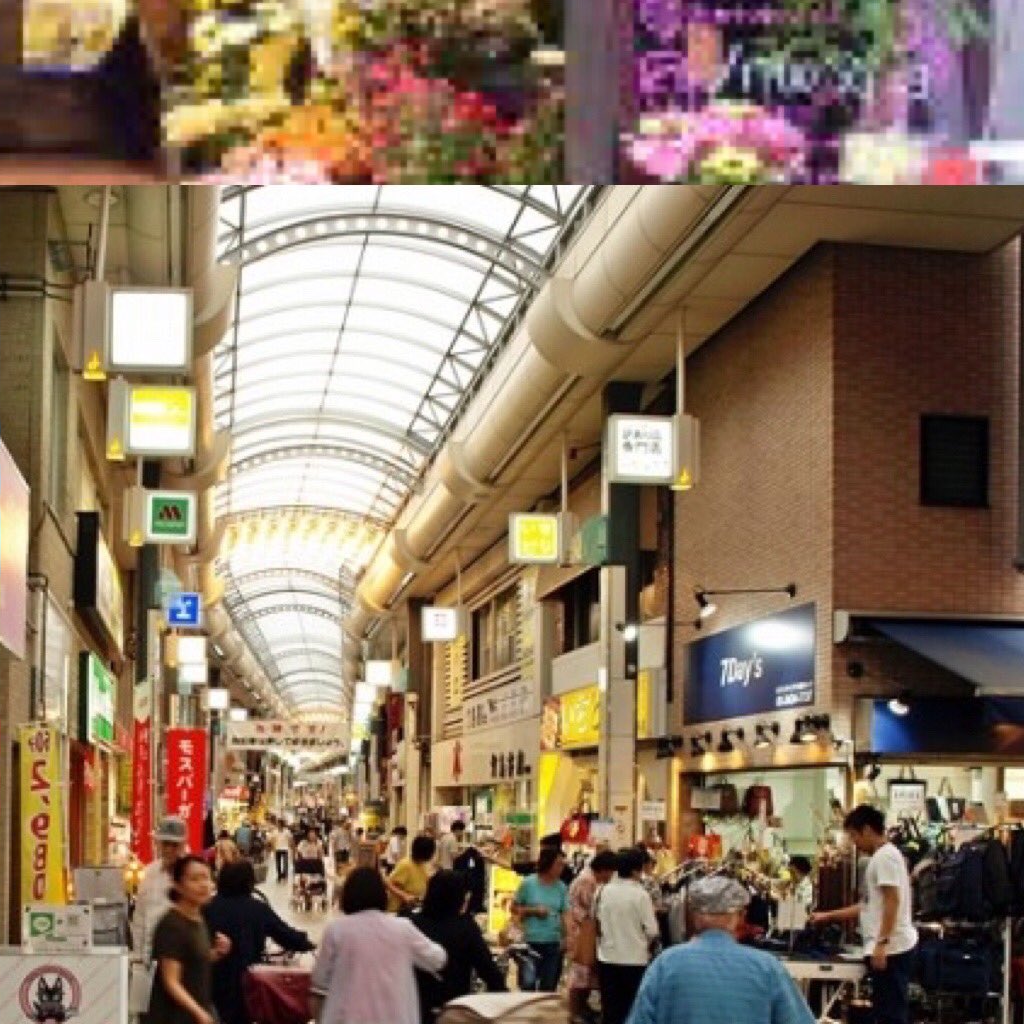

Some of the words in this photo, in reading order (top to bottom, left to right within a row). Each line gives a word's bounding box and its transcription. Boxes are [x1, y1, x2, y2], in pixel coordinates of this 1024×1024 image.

[176, 739, 195, 854] モスバーガ
